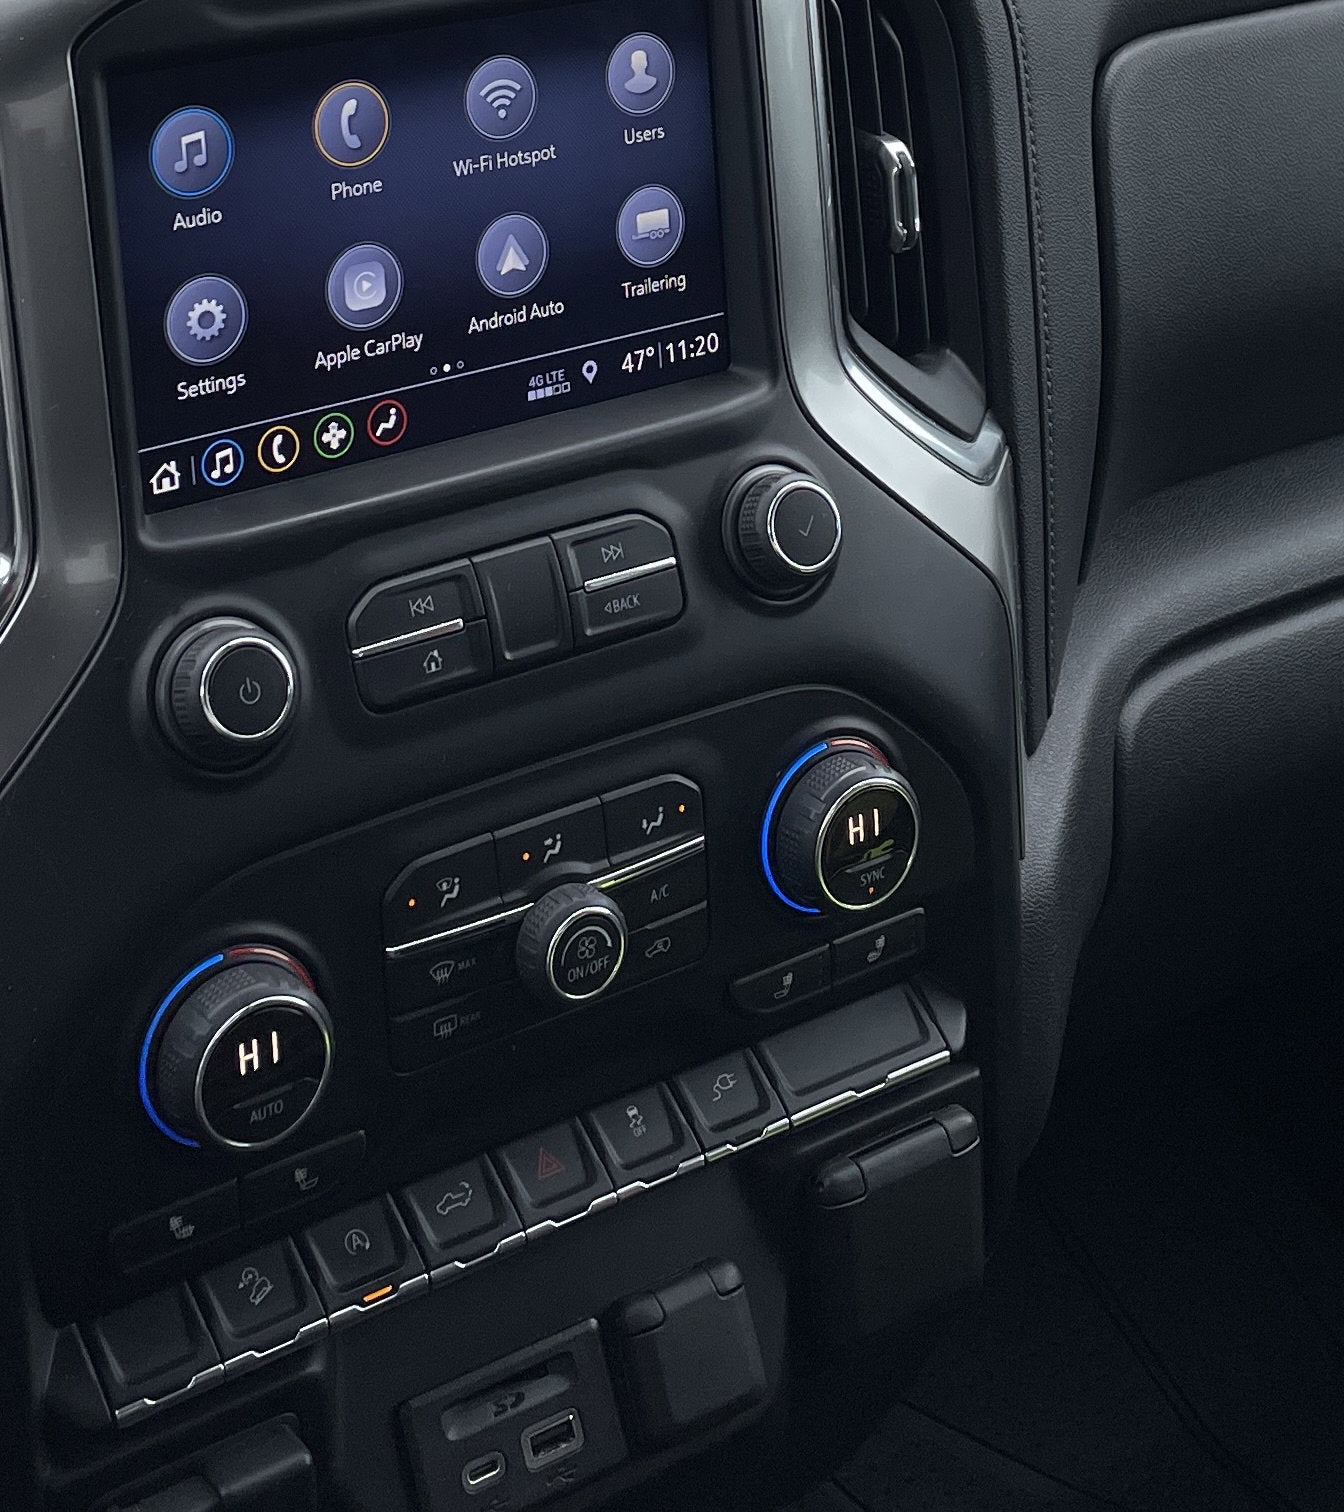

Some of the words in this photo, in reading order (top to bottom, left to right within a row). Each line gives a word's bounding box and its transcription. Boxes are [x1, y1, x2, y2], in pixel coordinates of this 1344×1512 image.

[625, 127, 664, 144] Users
[453, 155, 492, 176] Wi-Fi
[497, 145, 556, 168] Hotspot
[331, 177, 383, 201] Phone
[174, 208, 222, 230] Audio
[621, 275, 686, 298] Trailering
[467, 305, 527, 335] Android
[529, 301, 565, 322] Auto
[315, 345, 360, 371] Apple
[362, 331, 423, 357] CarPlay
[622, 347, 654, 372] 47°
[666, 333, 718, 362] 11:20
[178, 374, 246, 400] Settings
[528, 374, 544, 388] 4G
[545, 369, 565, 383] LTE
[612, 593, 641, 613] BACK
[848, 807, 879, 846] HI
[860, 867, 885, 887] SYNC
[649, 884, 670, 904] A/C
[567, 955, 610, 983] ON/OFF
[238, 1030, 279, 1076] HI
[249, 1099, 284, 1124] AUTO
